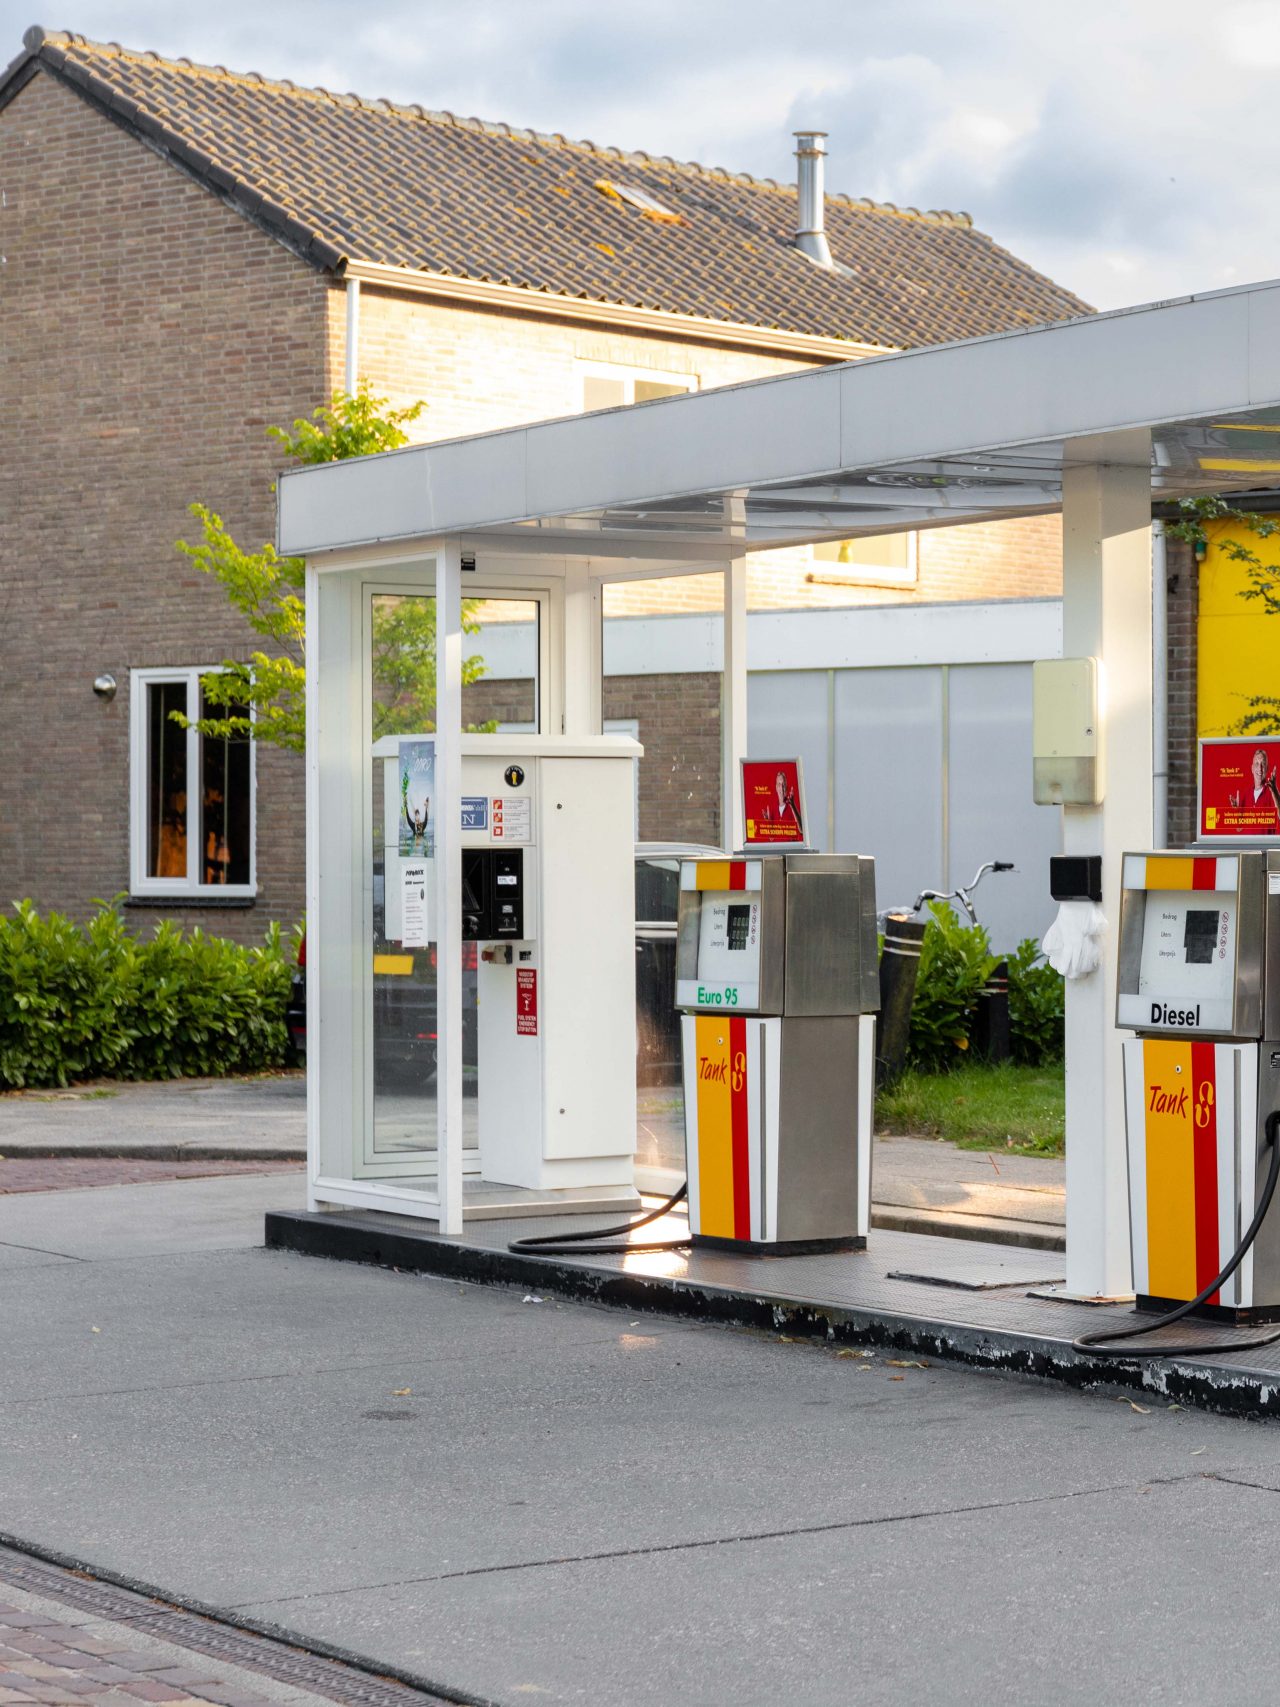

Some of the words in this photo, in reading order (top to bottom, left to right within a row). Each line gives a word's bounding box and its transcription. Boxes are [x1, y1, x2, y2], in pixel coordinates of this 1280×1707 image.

[1162, 913, 1177, 921] Bedrag
[697, 987, 722, 1005] Euro
[725, 988, 738, 1005] 95
[1150, 1003, 1200, 1026] Diesel
[700, 1057, 728, 1084] Tank
[1150, 1086, 1189, 1119] Tank
